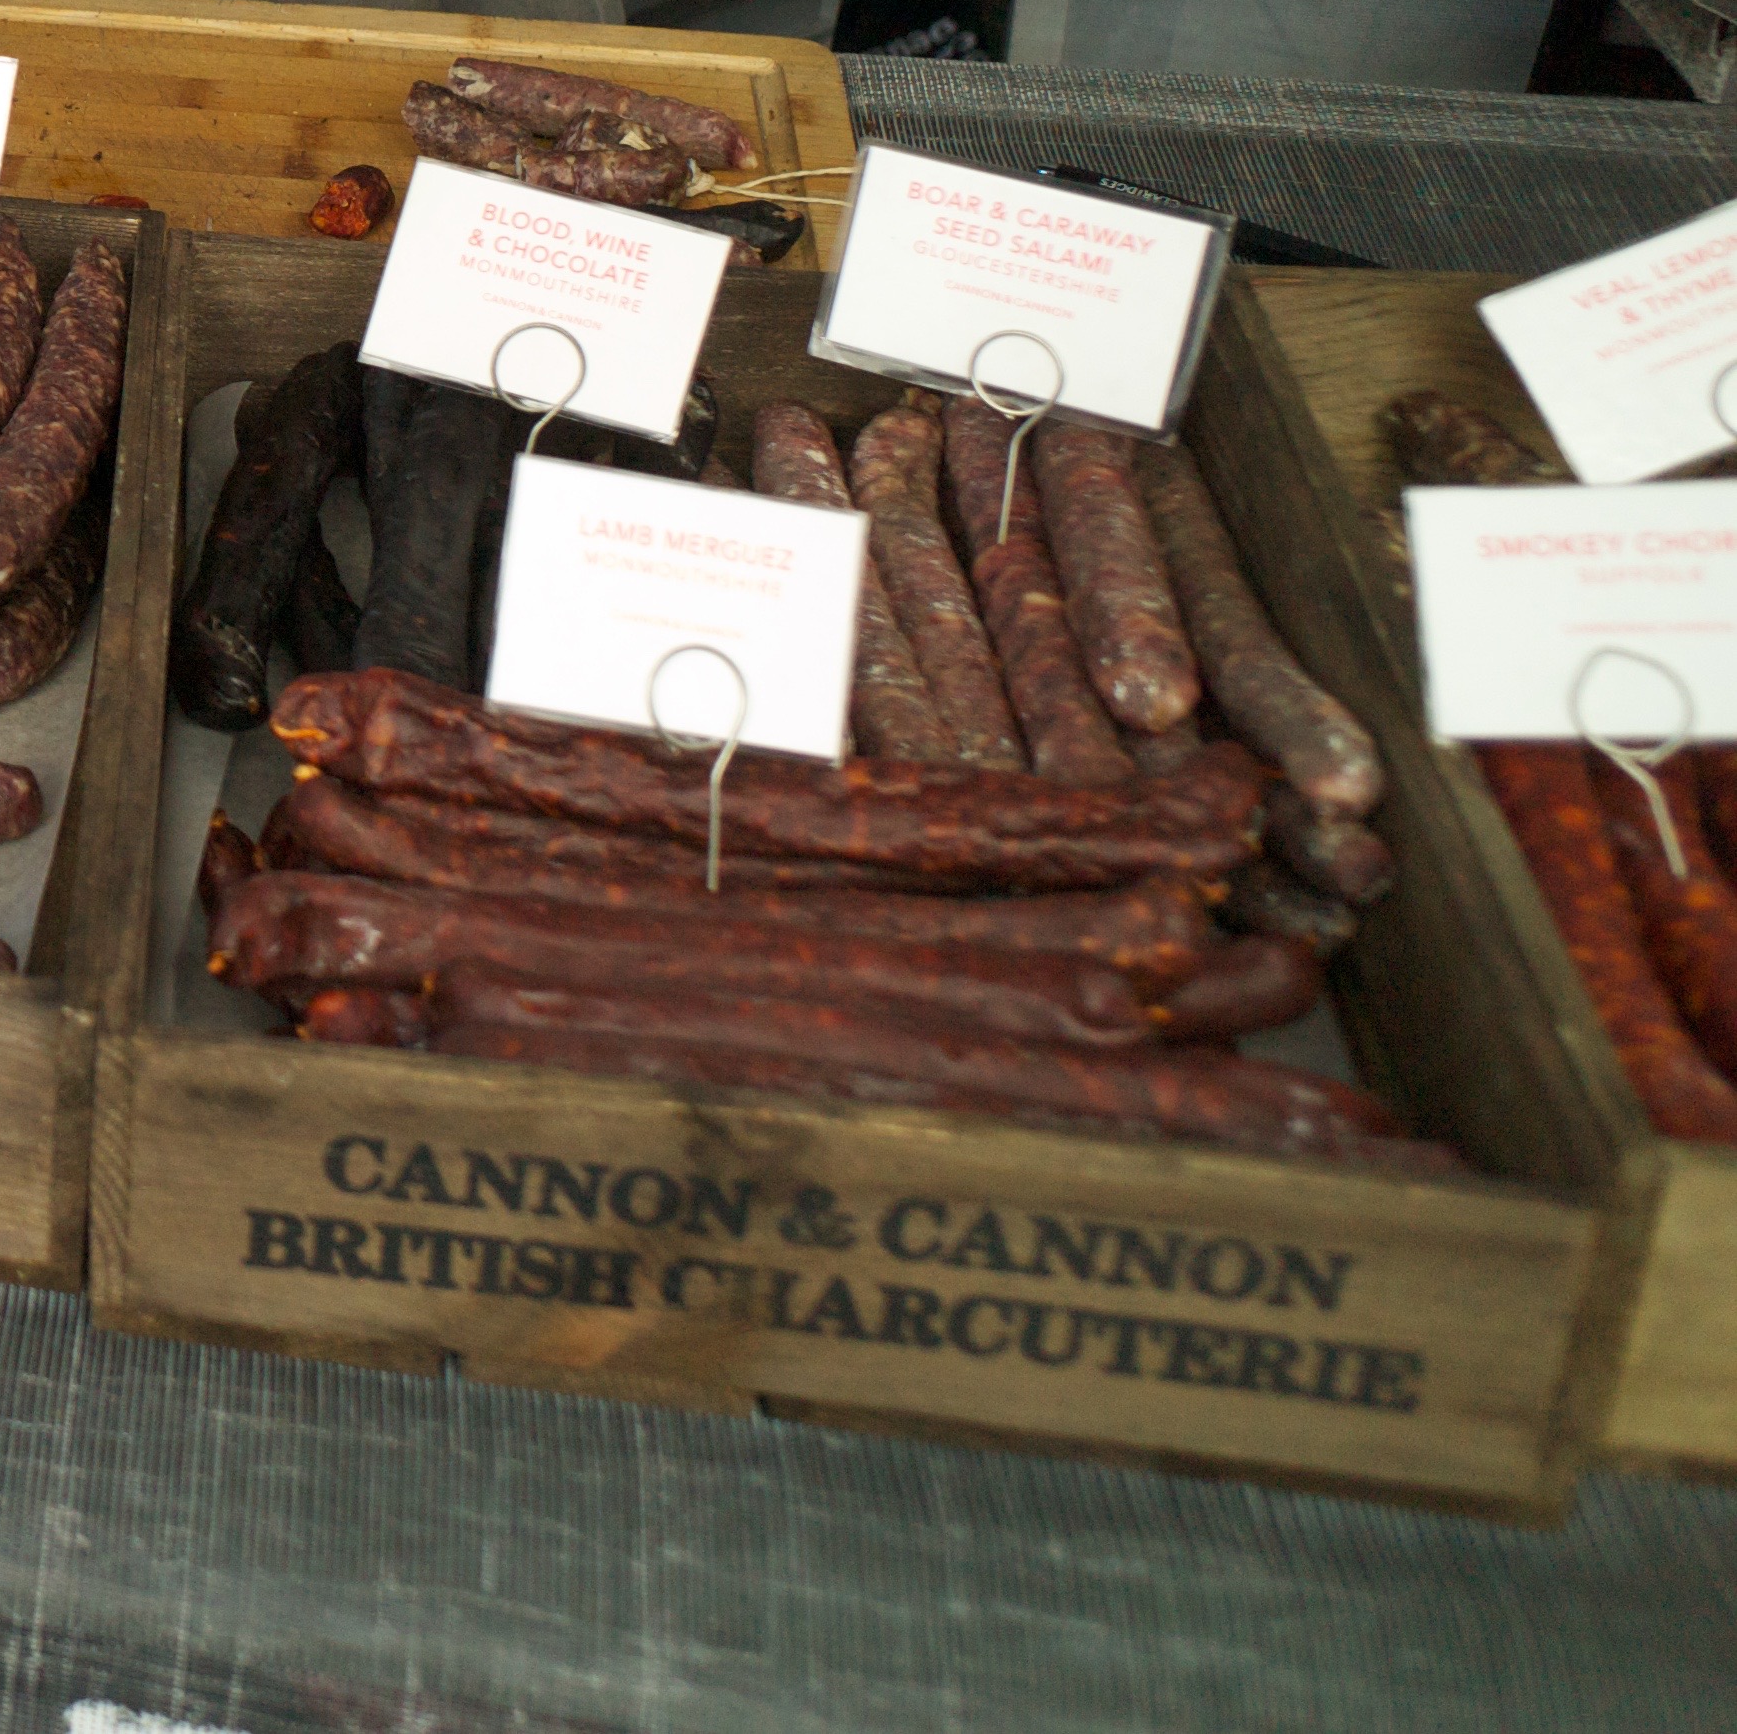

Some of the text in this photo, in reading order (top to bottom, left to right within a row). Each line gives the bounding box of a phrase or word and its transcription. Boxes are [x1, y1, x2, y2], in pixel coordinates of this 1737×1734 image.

[481, 202, 653, 263] BLOOD, WINE
[906, 180, 1157, 256] BOAR & CARAWAY
[932, 215, 1114, 276] SEED SALAMI
[458, 253, 644, 315] MONMOUTHSHIRE
[467, 228, 650, 291] & CHOCOLATE
[912, 239, 1121, 304] GLOUCESTERSHIRE
[577, 513, 795, 572] LAMB MERGUEZ
[324, 1133, 1356, 1314] CANNON & CANNON
[243, 1209, 634, 1309] BRITISH
